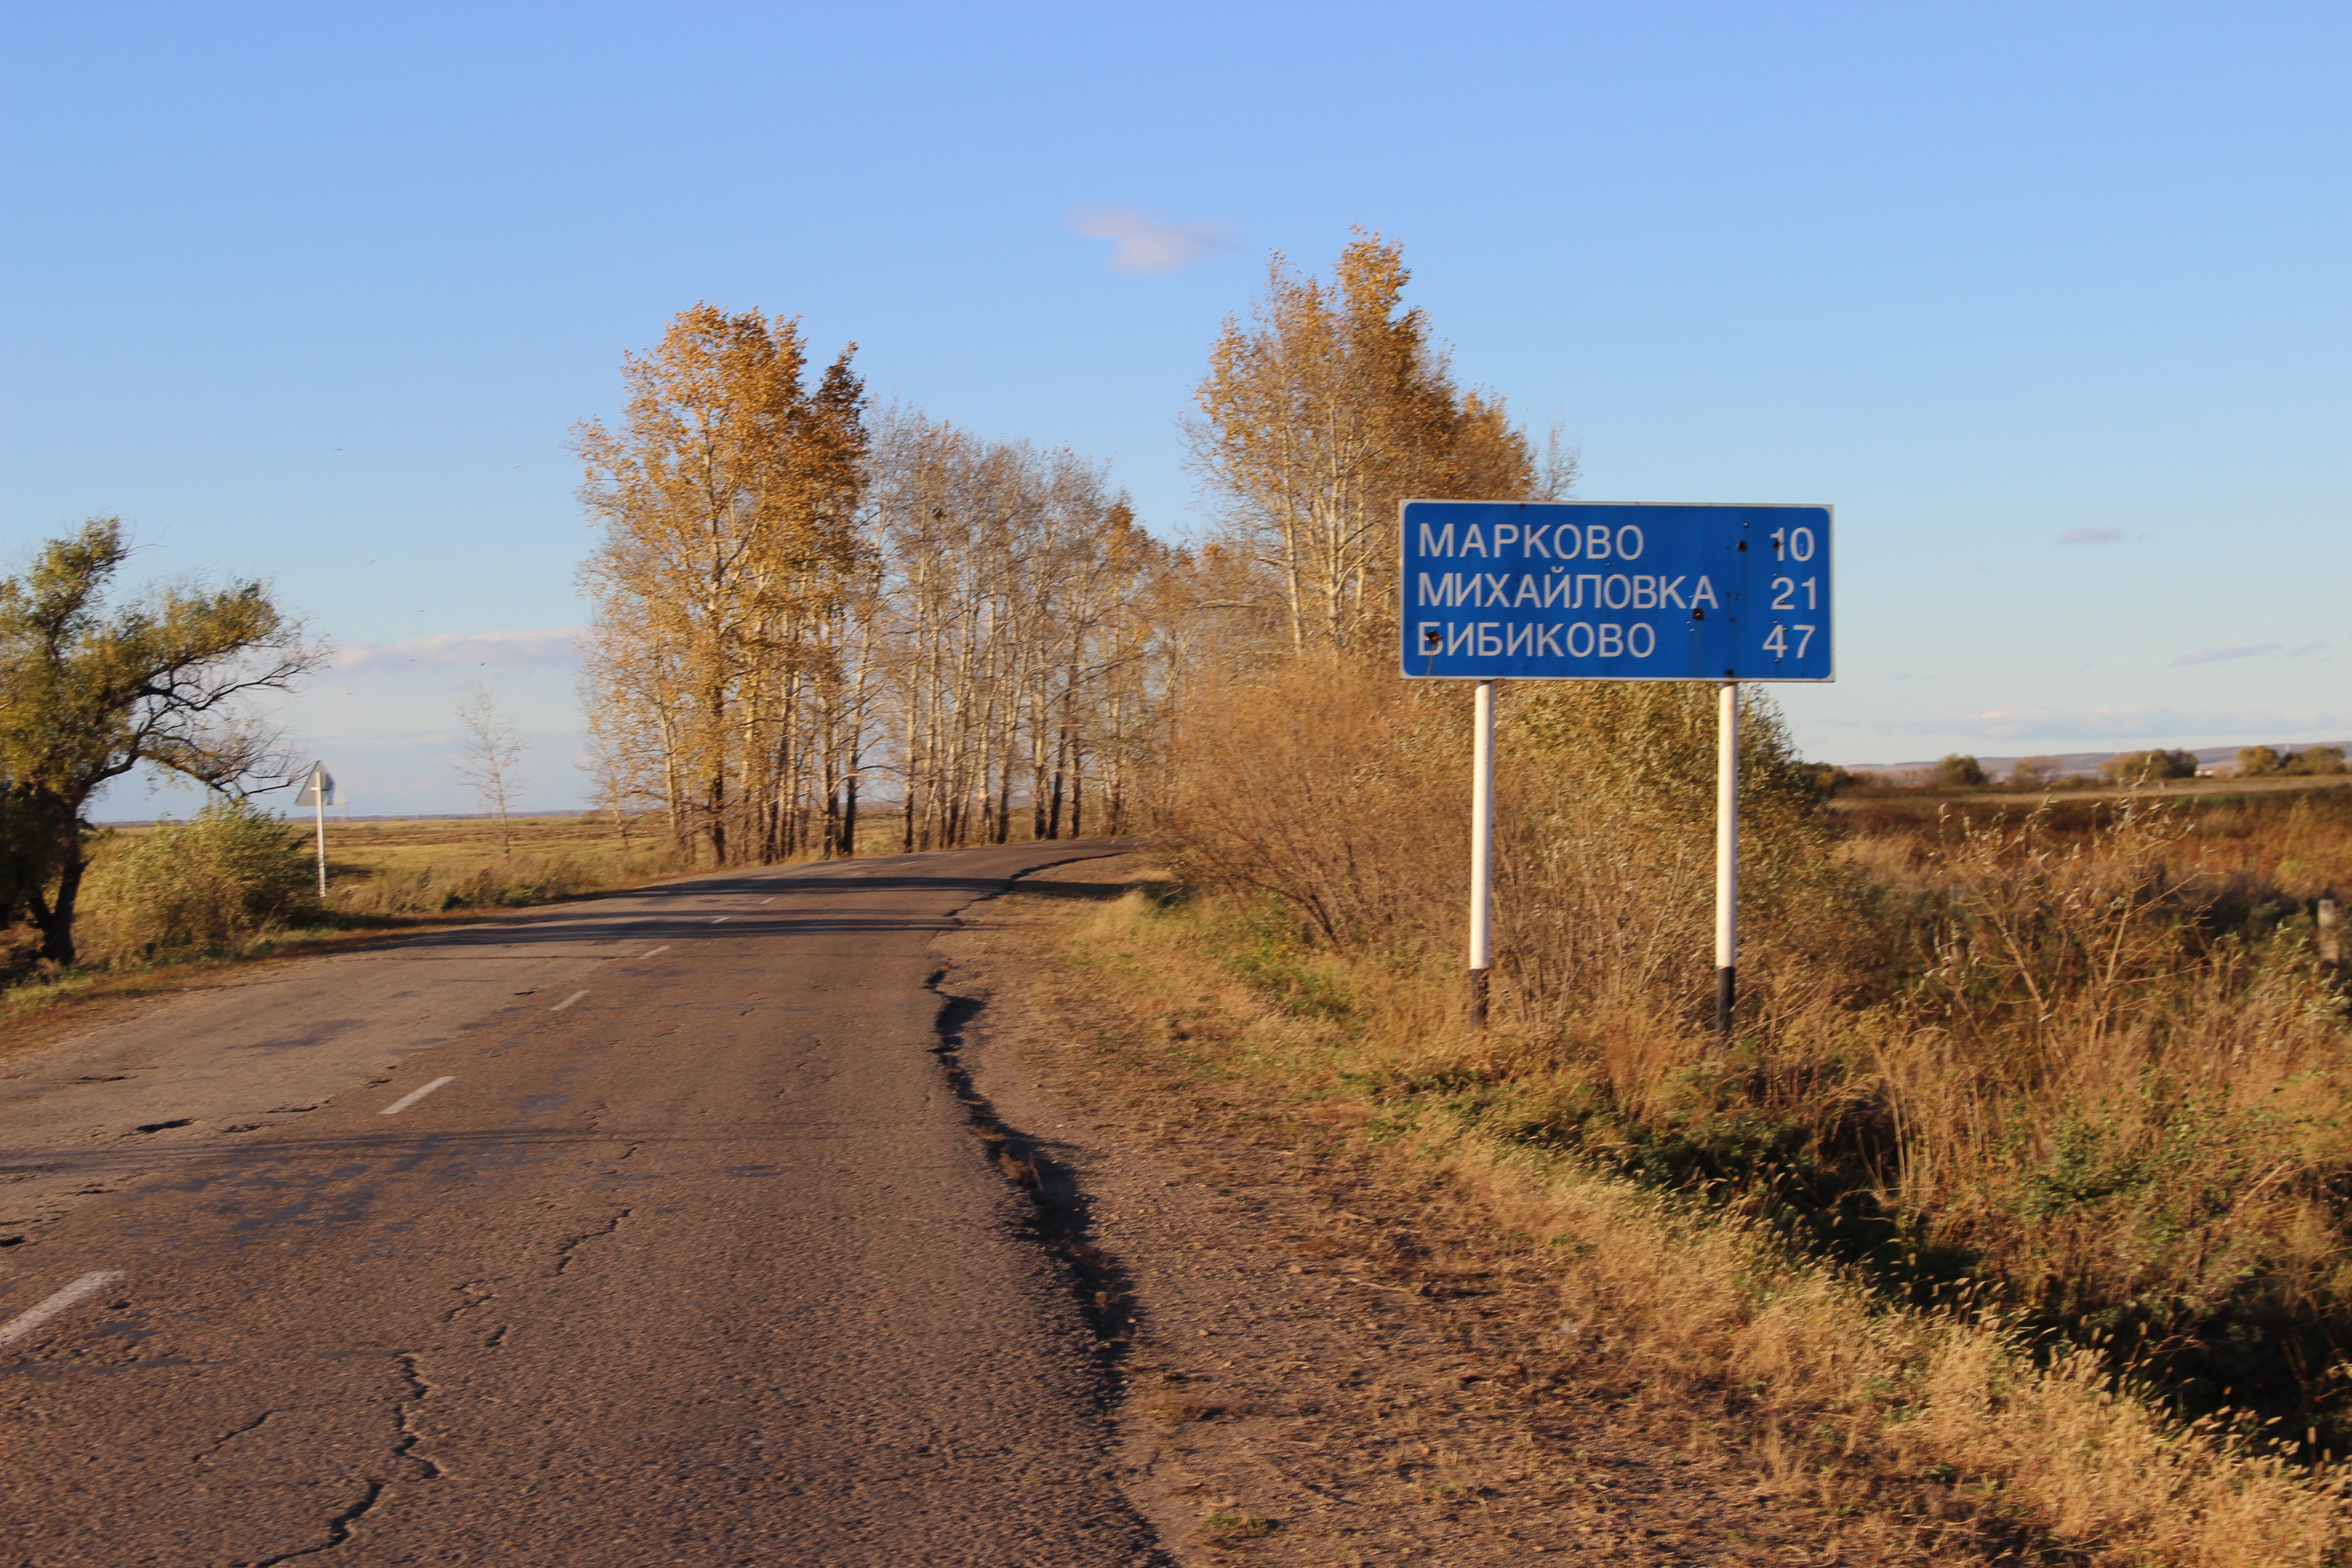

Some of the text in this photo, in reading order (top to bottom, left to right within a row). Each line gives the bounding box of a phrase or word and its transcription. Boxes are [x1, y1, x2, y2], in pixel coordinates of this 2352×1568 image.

[1419, 523, 1815, 561] МАРКОВО 10
[1418, 566, 1816, 610] МИХАЙЛОВКА 21
[1418, 621, 1816, 659] БИБИКОВО 47
